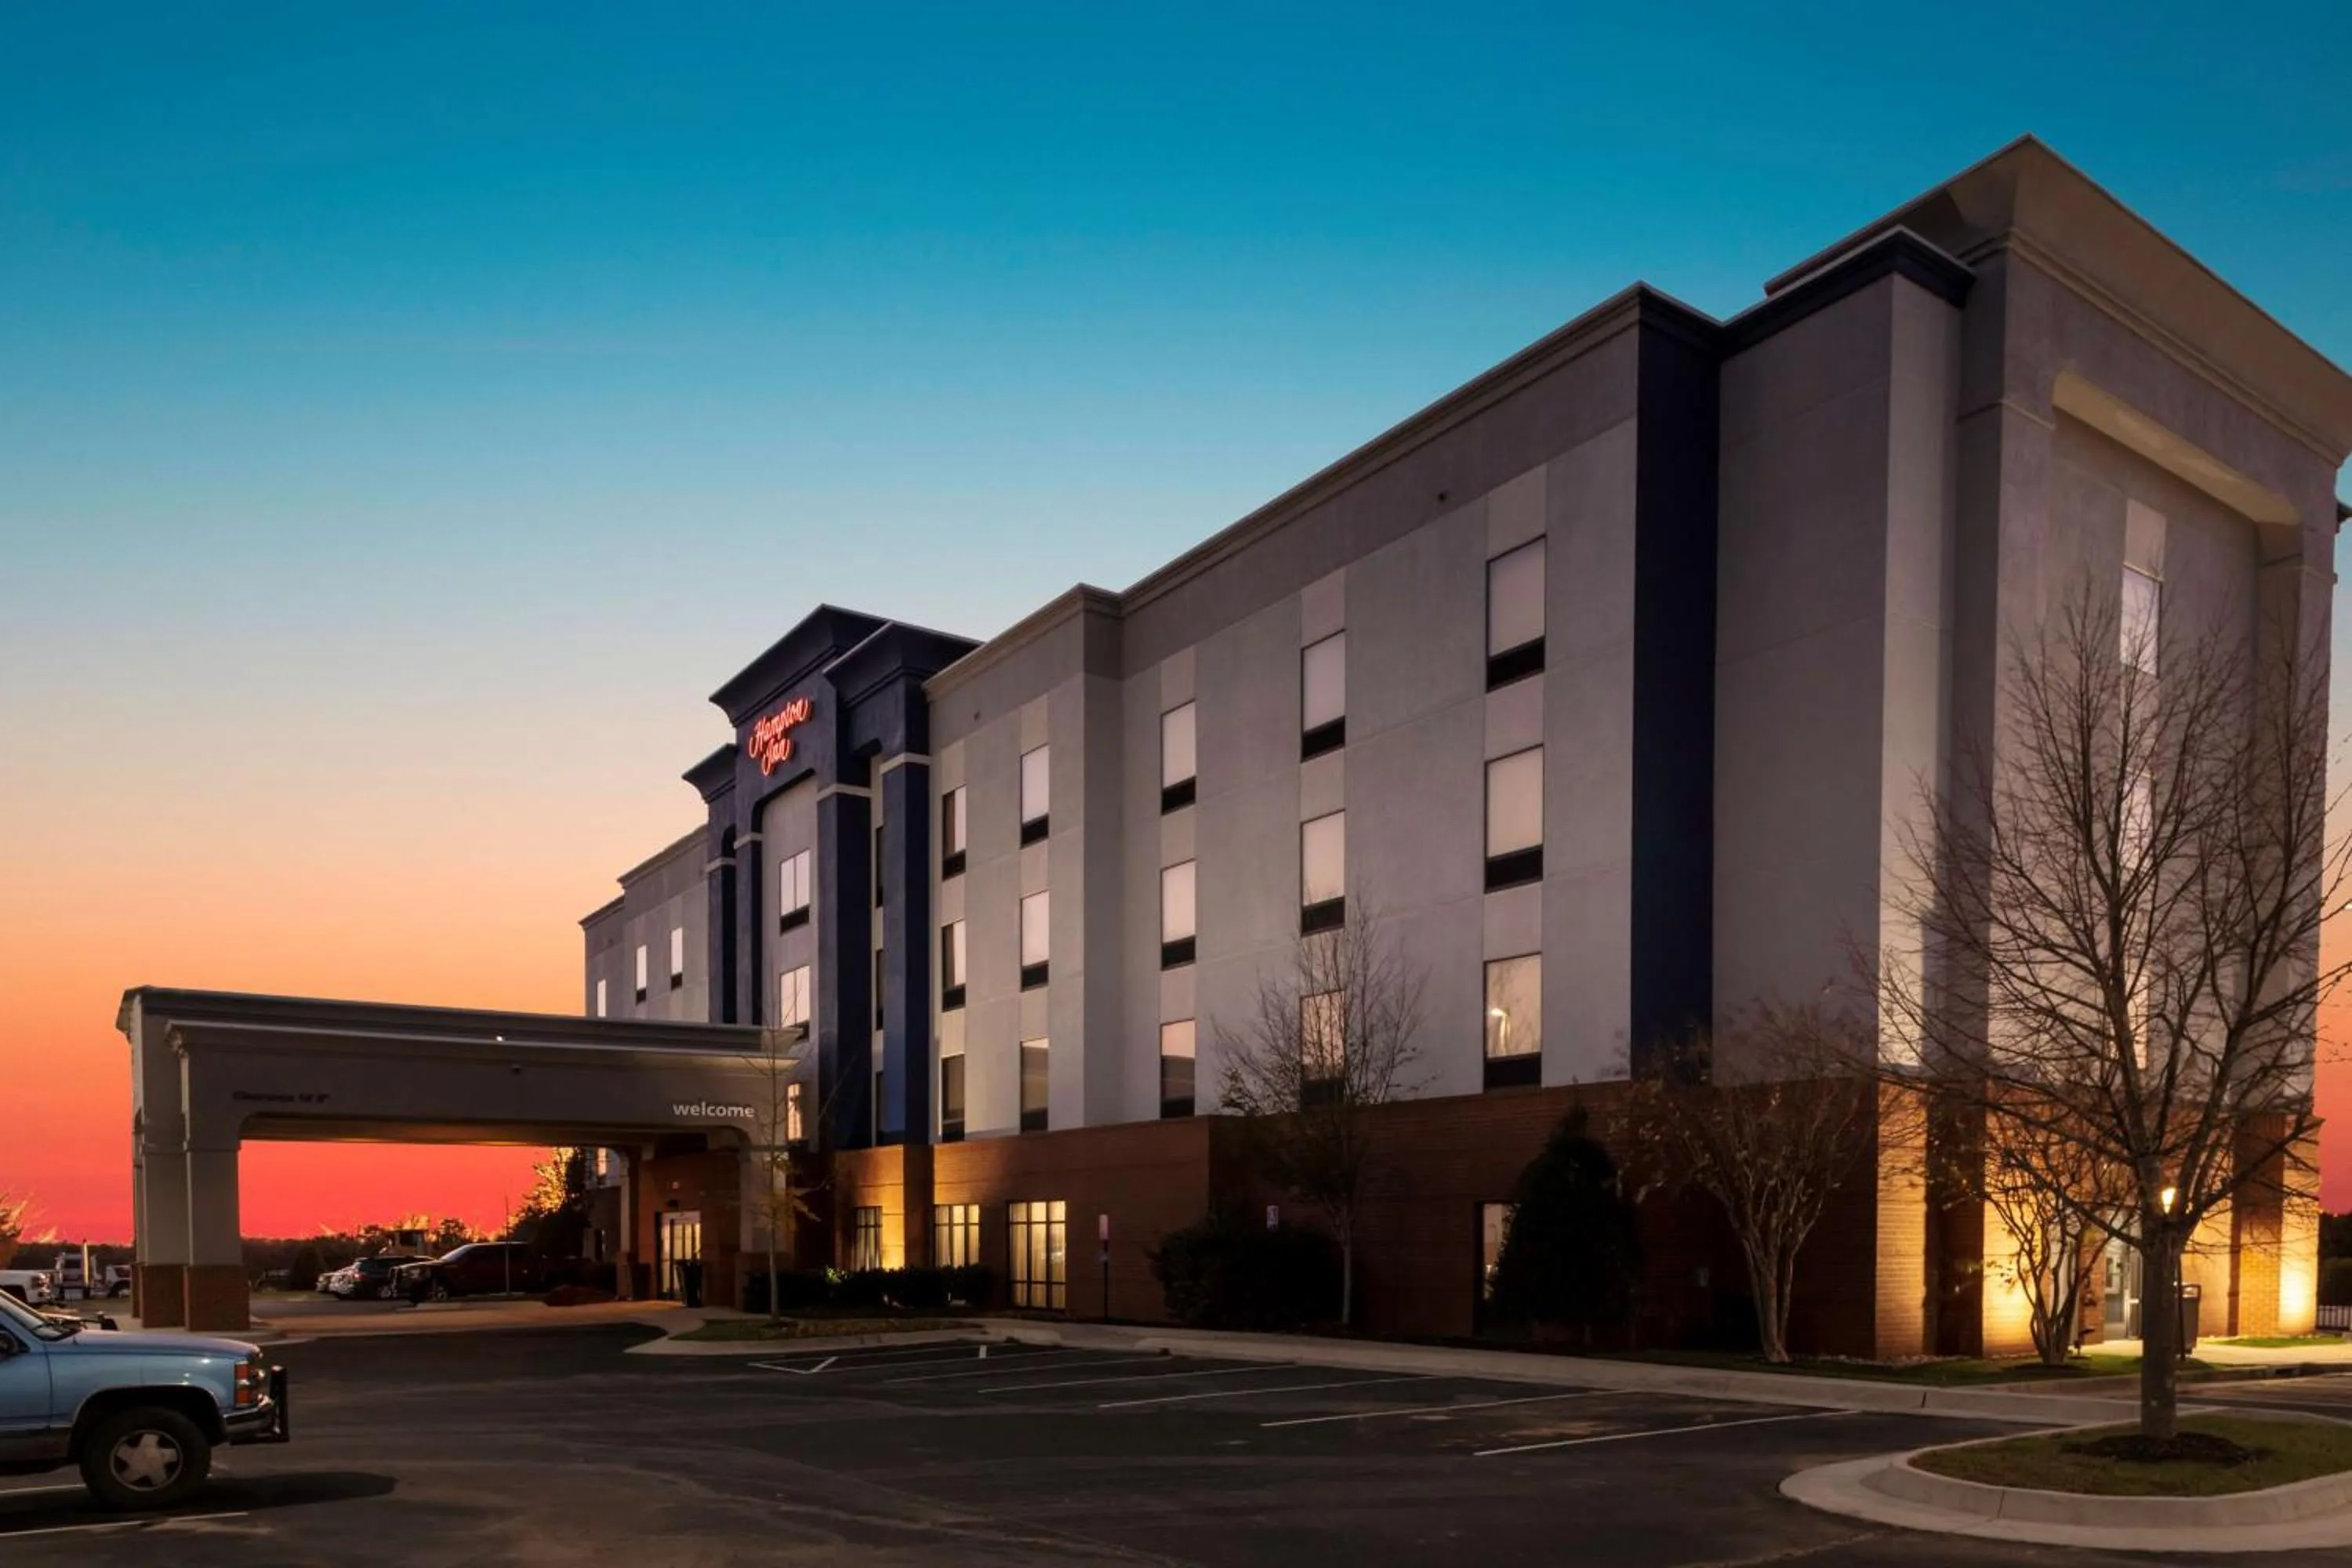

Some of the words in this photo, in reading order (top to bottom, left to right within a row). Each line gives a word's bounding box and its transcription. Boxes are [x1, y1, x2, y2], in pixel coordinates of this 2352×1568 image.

[749, 697, 809, 758] Hampton
[761, 738, 791, 776] Inn
[672, 1100, 755, 1117] welcome
